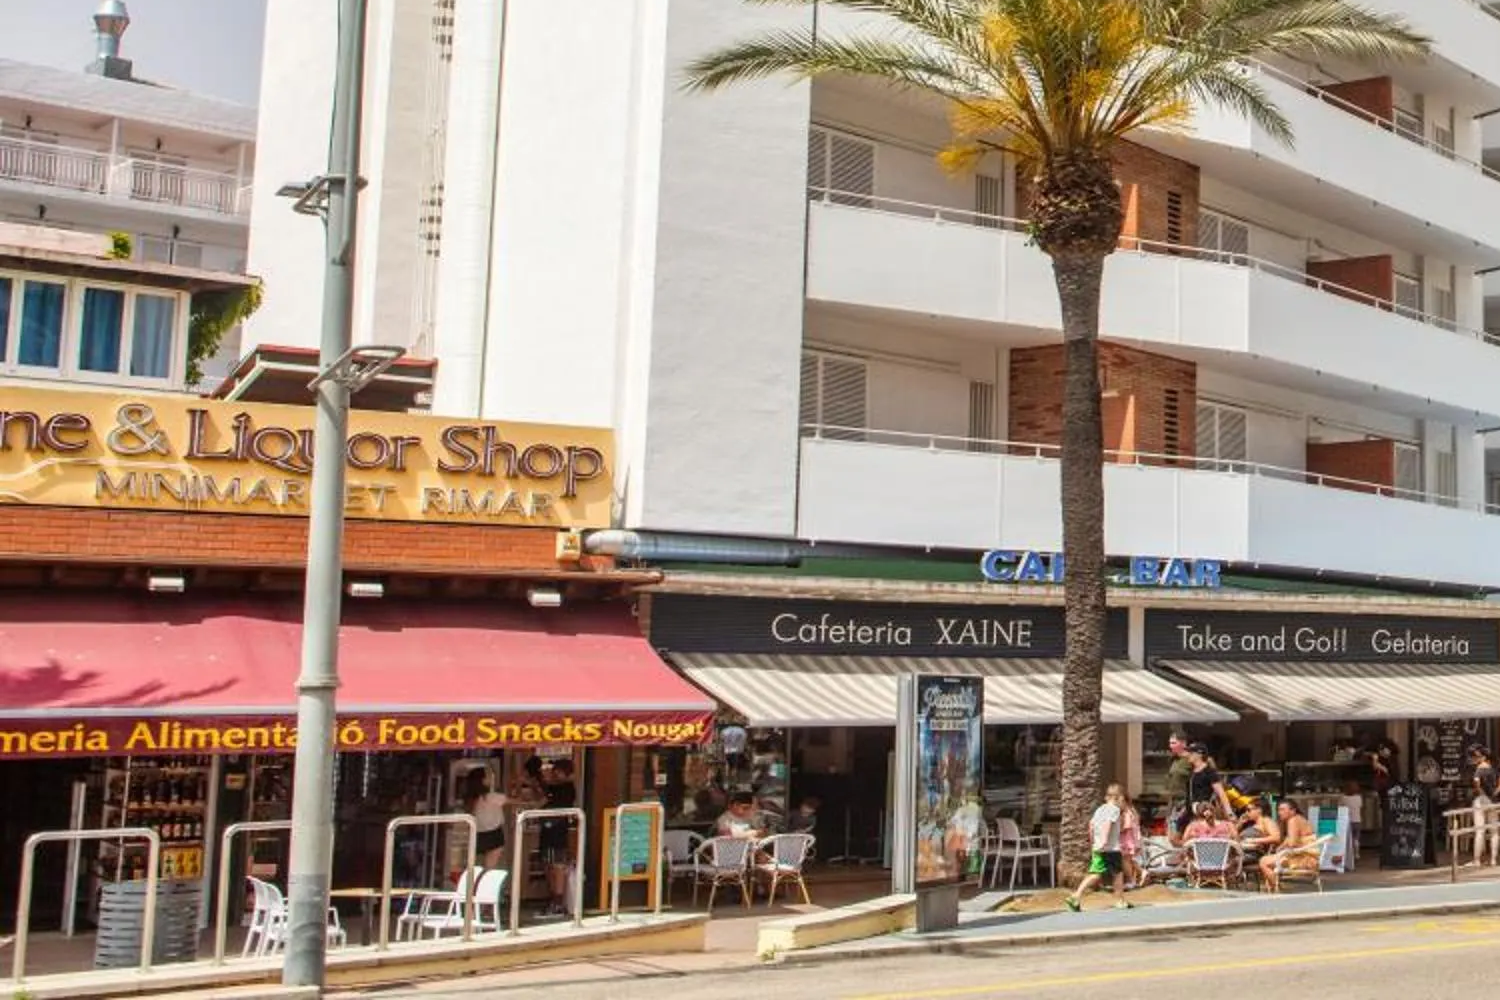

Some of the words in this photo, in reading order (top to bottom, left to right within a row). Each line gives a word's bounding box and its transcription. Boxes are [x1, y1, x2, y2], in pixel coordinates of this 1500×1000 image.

[107, 403, 170, 455] &
[437, 425, 604, 498] Shop
[95, 471, 396, 513] MINIMARET
[421, 487, 554, 519] RIMAR
[1129, 555, 1222, 587] BAR
[771, 613, 912, 645] Cafeteria
[934, 618, 1033, 648] XAINE
[1176, 624, 1233, 651] Take
[1241, 626, 1285, 652] and
[1295, 627, 1347, 653] Go!!
[1371, 629, 1470, 655] Gelateria
[124, 719, 365, 750] Alimentaió
[378, 717, 465, 746] Food
[476, 717, 602, 744] Snacks
[613, 719, 705, 742] Nougat
